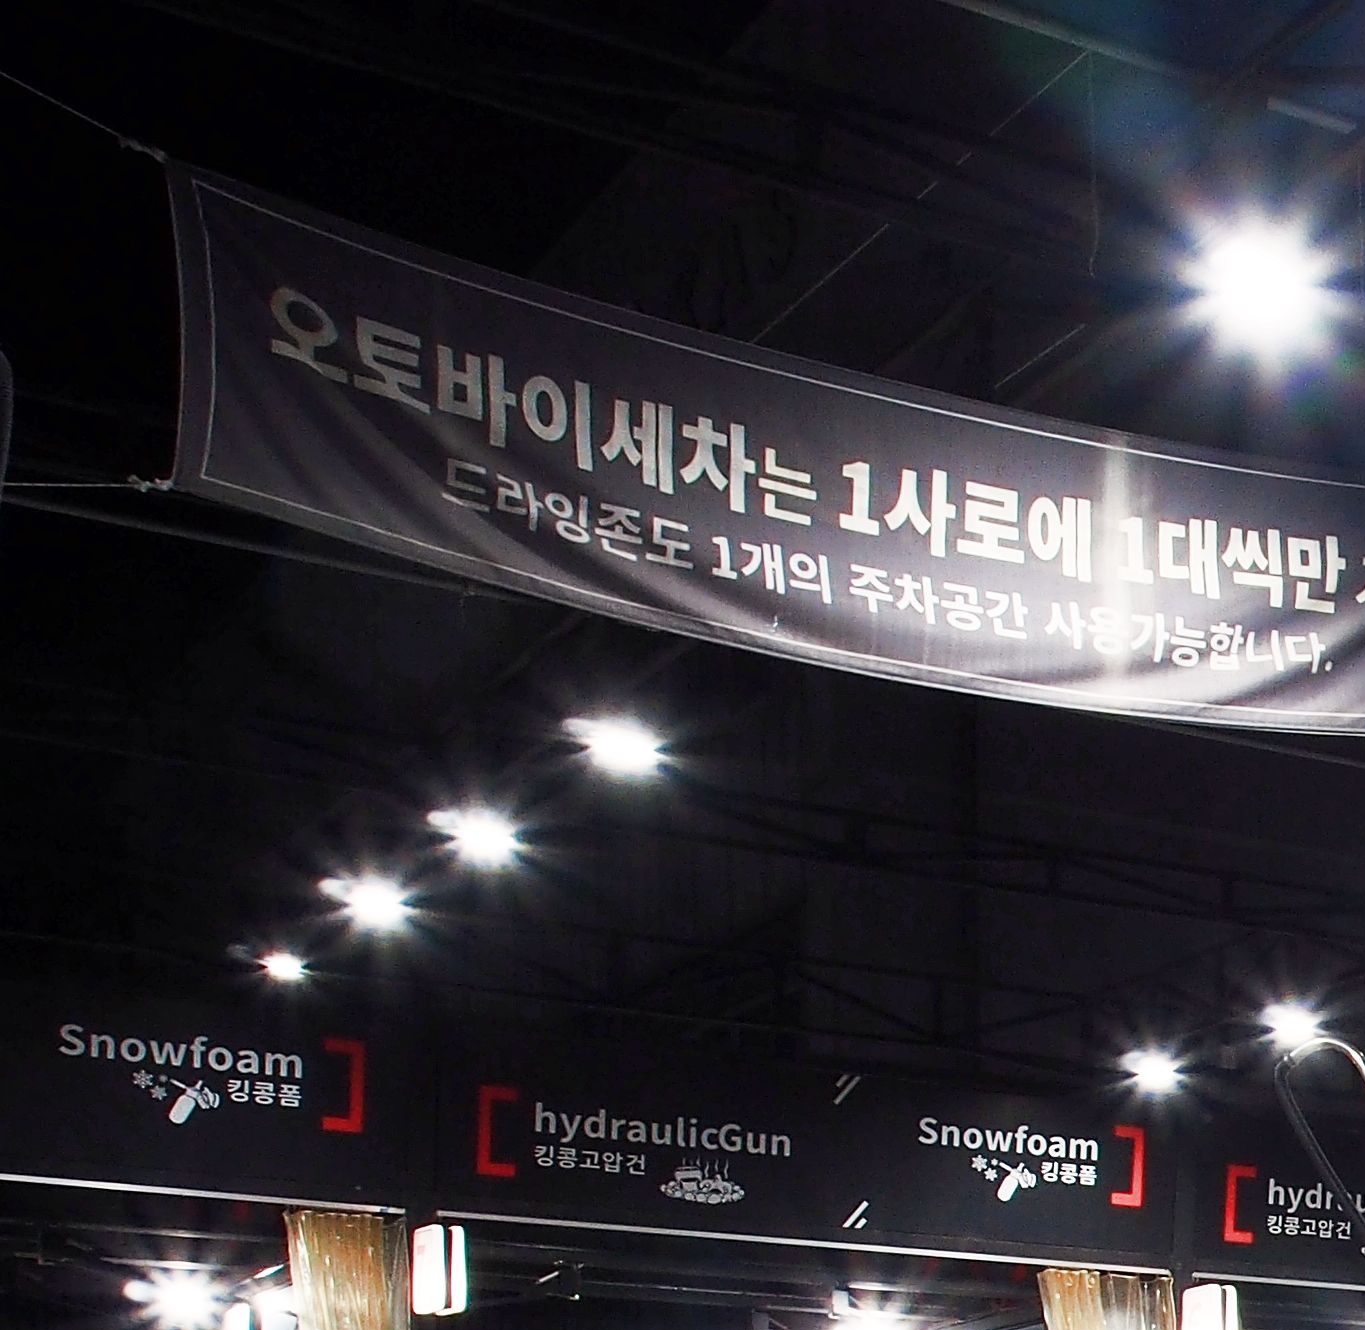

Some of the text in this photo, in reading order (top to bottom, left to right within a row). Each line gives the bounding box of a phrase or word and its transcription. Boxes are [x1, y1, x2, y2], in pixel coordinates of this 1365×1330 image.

[269, 286, 818, 526] 오토바이세차는
[838, 460, 1093, 582] 1사로에
[1116, 515, 1347, 615] 1대씩만
[440, 456, 1333, 673] 드라잉존도 1개의 주차공간 사용가능합니다.
[57, 1022, 303, 1079] Snowfoam
[225, 1079, 303, 1109] 킹콩폼
[533, 1102, 792, 1158] hydraulicGun
[918, 1116, 1099, 1161] Snowfoam
[533, 1144, 648, 1176] 킹콩고압건
[1040, 1160, 1098, 1187] 킹콩폼
[1267, 1214, 1351, 1240] 킹콩고압건
